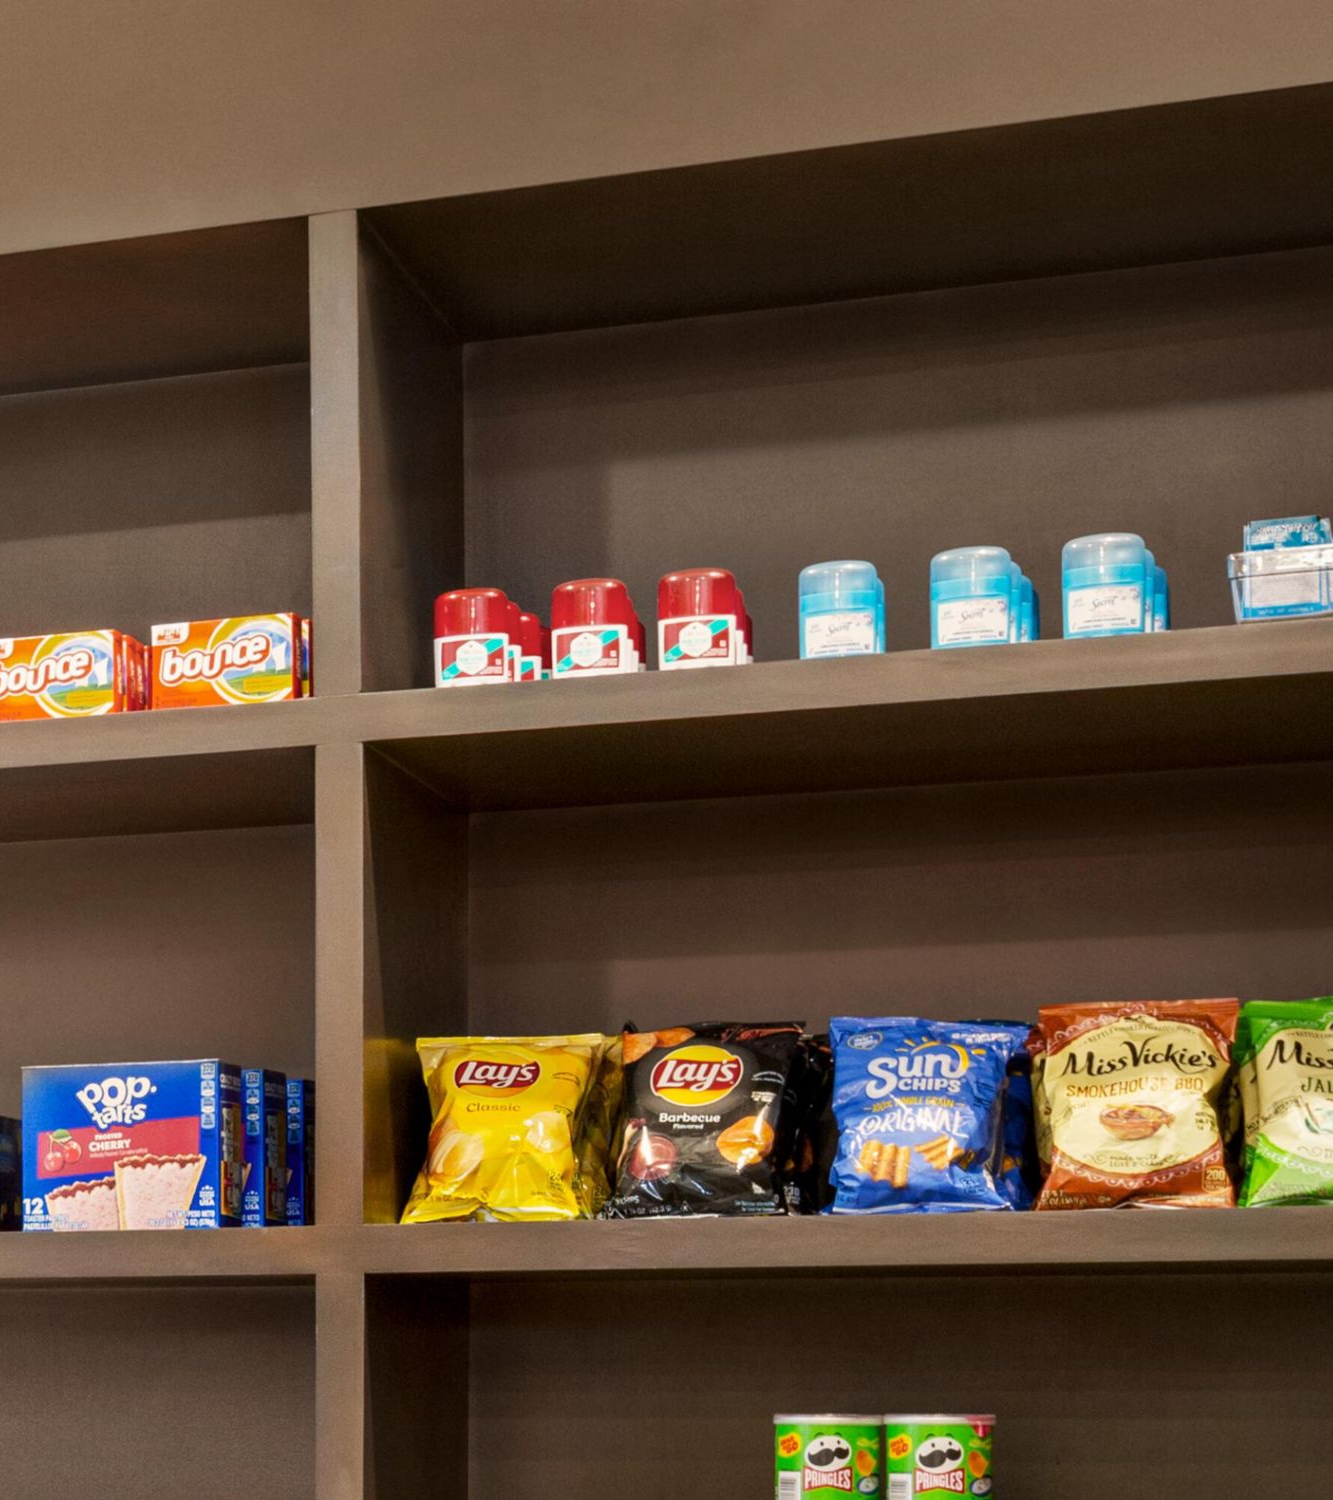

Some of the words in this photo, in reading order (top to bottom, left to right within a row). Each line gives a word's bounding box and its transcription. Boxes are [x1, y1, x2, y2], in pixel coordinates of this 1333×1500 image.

[1091, 597, 1116, 612] Secret
[960, 607, 985, 623] Secret
[163, 635, 269, 682] bounce
[1062, 1051, 1126, 1077] Miss
[1122, 1036, 1218, 1073] Vickie's
[458, 1058, 536, 1088] Lay's
[656, 1057, 740, 1092] Lay's
[865, 1053, 967, 1099] Sun
[897, 1077, 961, 1093] CHIPS
[1066, 1077, 1169, 1098] SMOKEHOUSE
[1174, 1077, 1204, 1091] BBQ
[466, 1101, 521, 1113] Classic
[658, 1112, 721, 1124] Barbecue
[672, 1122, 704, 1130] Flavored
[859, 1106, 968, 1138] ORIGINAL
[88, 1139, 132, 1152] CHERRY
[1206, 1170, 1225, 1181] 200
[23, 1198, 44, 1214] 12
[199, 1199, 215, 1207] USA
[804, 1467, 852, 1490] PRINGLES
[915, 1468, 965, 1493] PRINGLES
